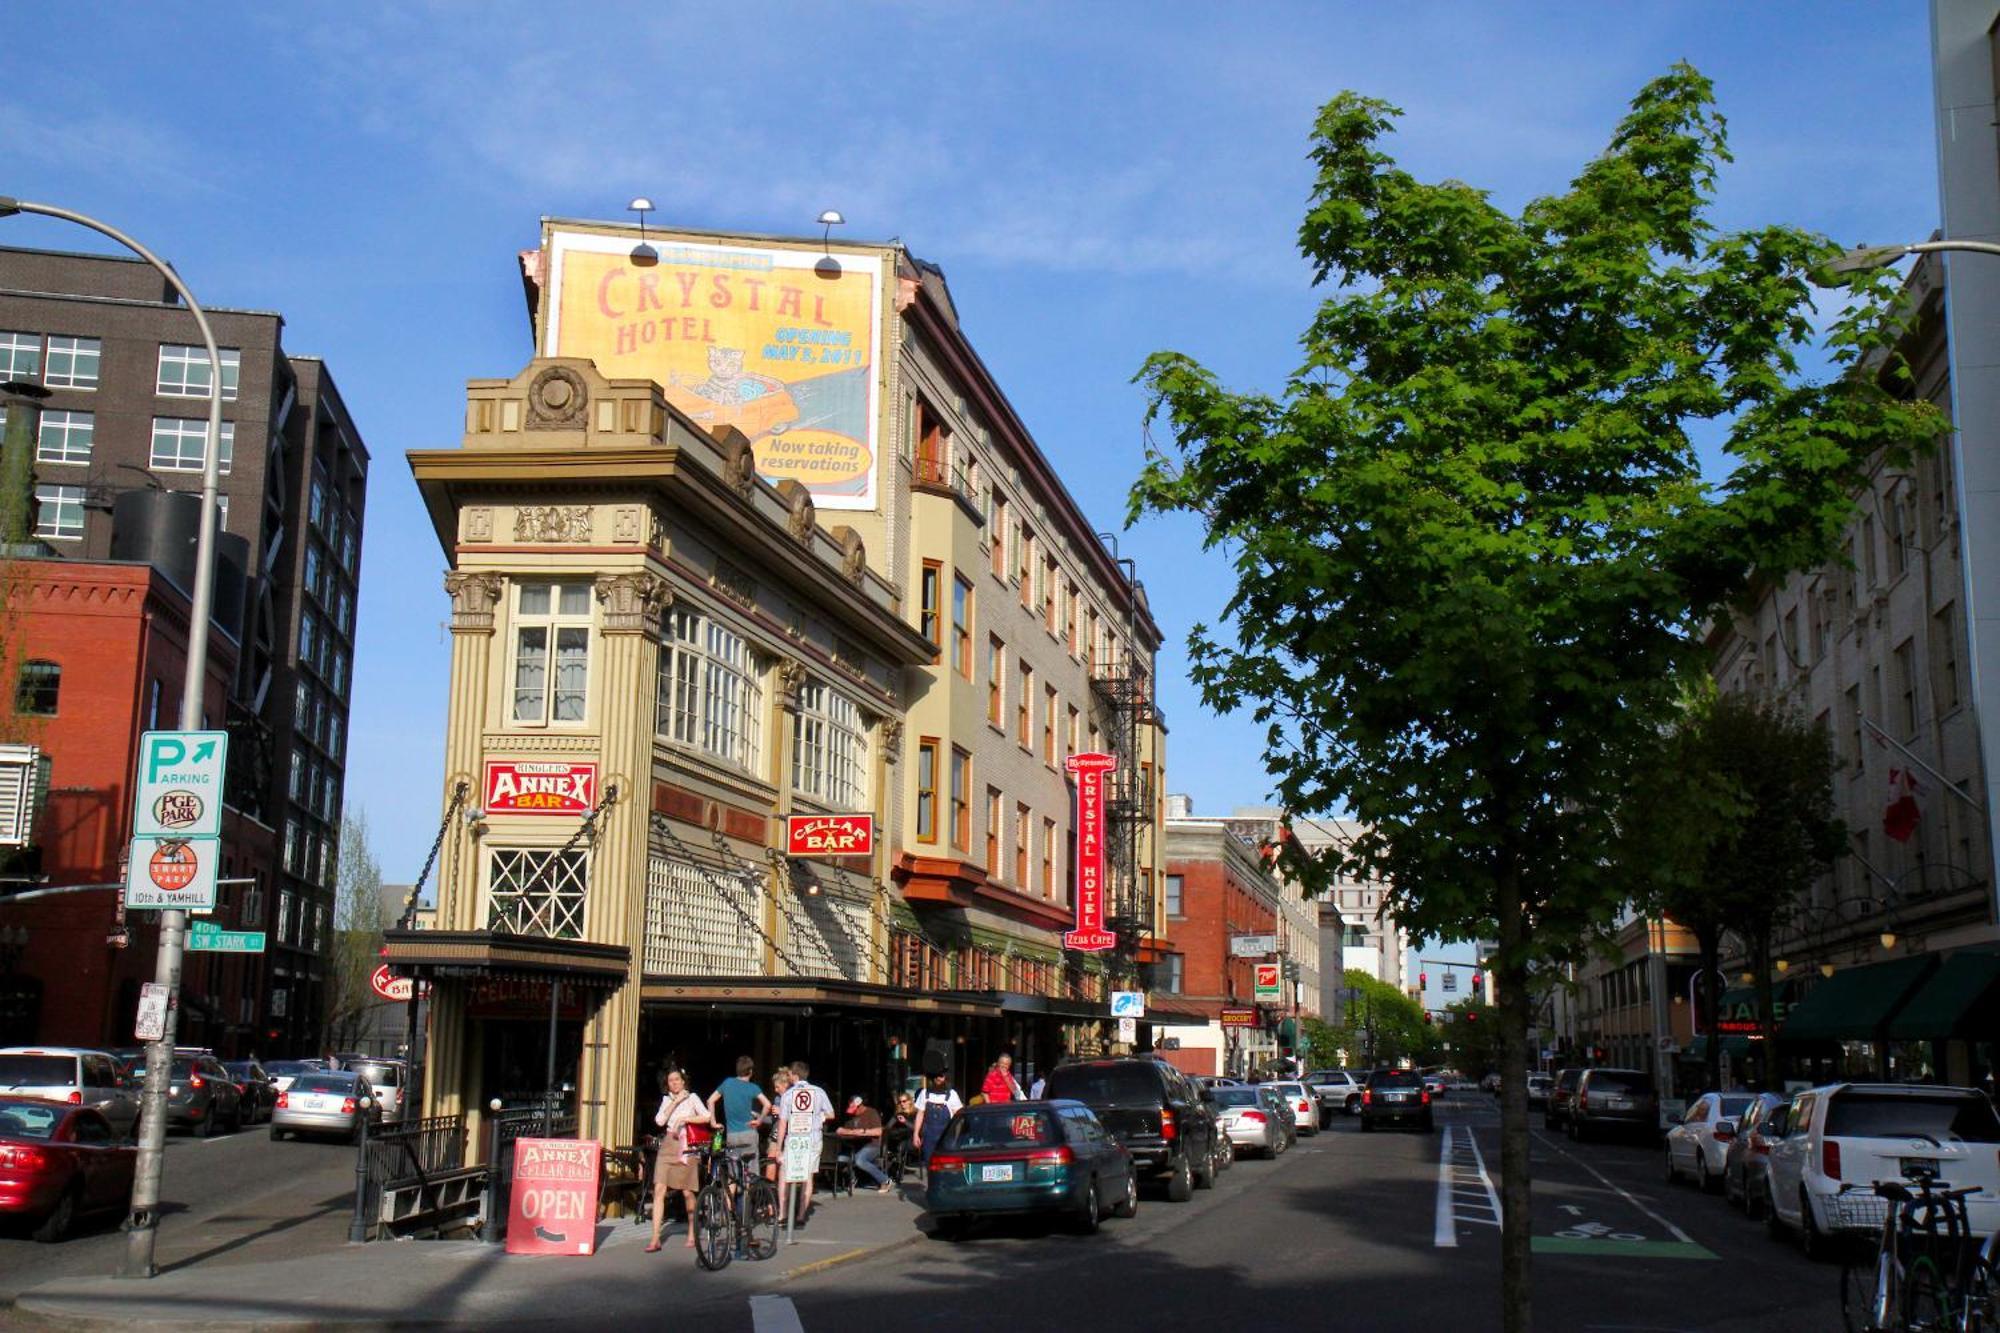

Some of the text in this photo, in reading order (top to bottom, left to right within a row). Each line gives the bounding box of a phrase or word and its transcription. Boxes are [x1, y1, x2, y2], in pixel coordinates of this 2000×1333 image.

[598, 268, 833, 326] CRYSTAL
[614, 317, 717, 355] HOTEL
[775, 328, 853, 347] OPENING
[762, 344, 799, 361] MAY
[819, 348, 863, 366] 2011
[770, 439, 860, 461] Now taking
[760, 456, 859, 474] reservations
[490, 773, 591, 806] ANNEX
[161, 795, 197, 811] PGE
[516, 795, 562, 808] BAR
[160, 808, 197, 826] PARK
[1084, 772, 1097, 856] CRYSTAL
[794, 818, 867, 842] CELLAR
[806, 835, 856, 848] BAR
[151, 864, 194, 874] SMART
[156, 875, 189, 884] PARK
[135, 893, 206, 904] 10th & YAMHILL
[1084, 867, 1096, 928] HOTEL
[195, 935, 211, 947] SW
[214, 935, 247, 947] STARK
[523, 1148, 591, 1167] ANNEX
[519, 1163, 564, 1177] CELLAR
[522, 1189, 586, 1219] OPEN
